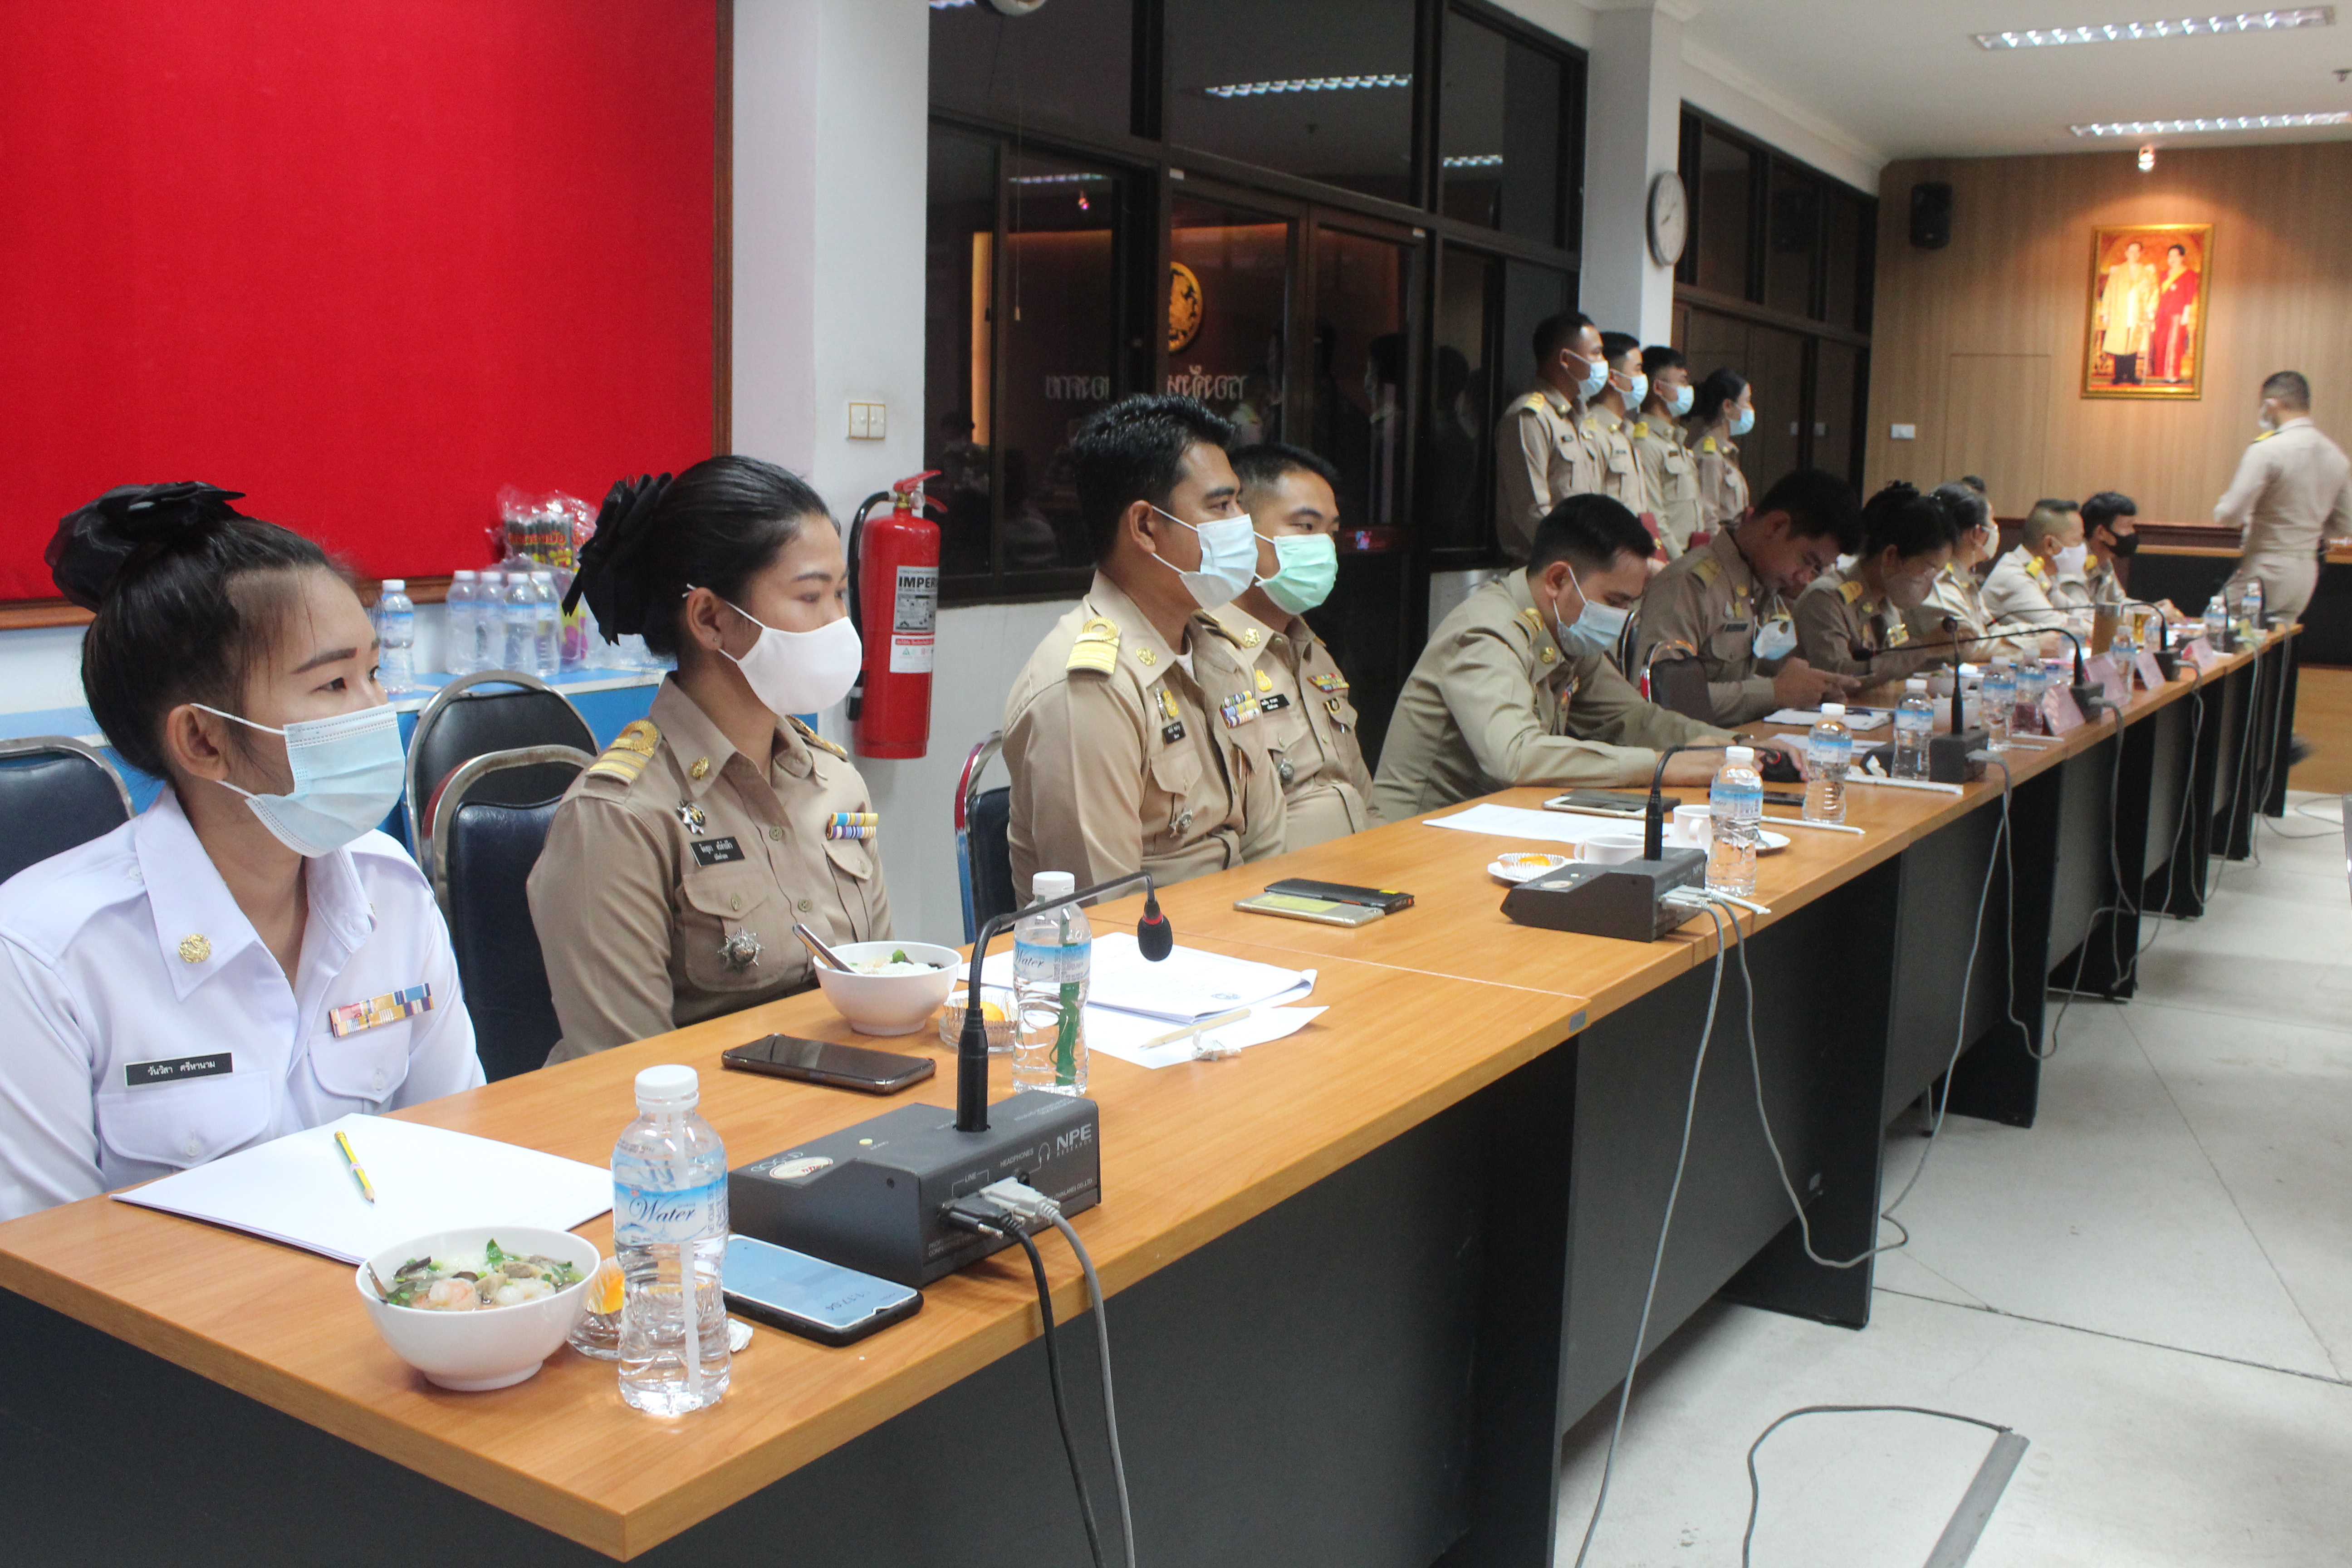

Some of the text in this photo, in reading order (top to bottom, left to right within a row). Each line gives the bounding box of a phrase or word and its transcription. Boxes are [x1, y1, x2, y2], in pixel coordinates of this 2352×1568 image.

[1057, 1123, 1092, 1151] NPE
[1000, 1147, 1034, 1168] HEADPHONES
[965, 1171, 976, 1182] LINE
[629, 1194, 696, 1223] Water
